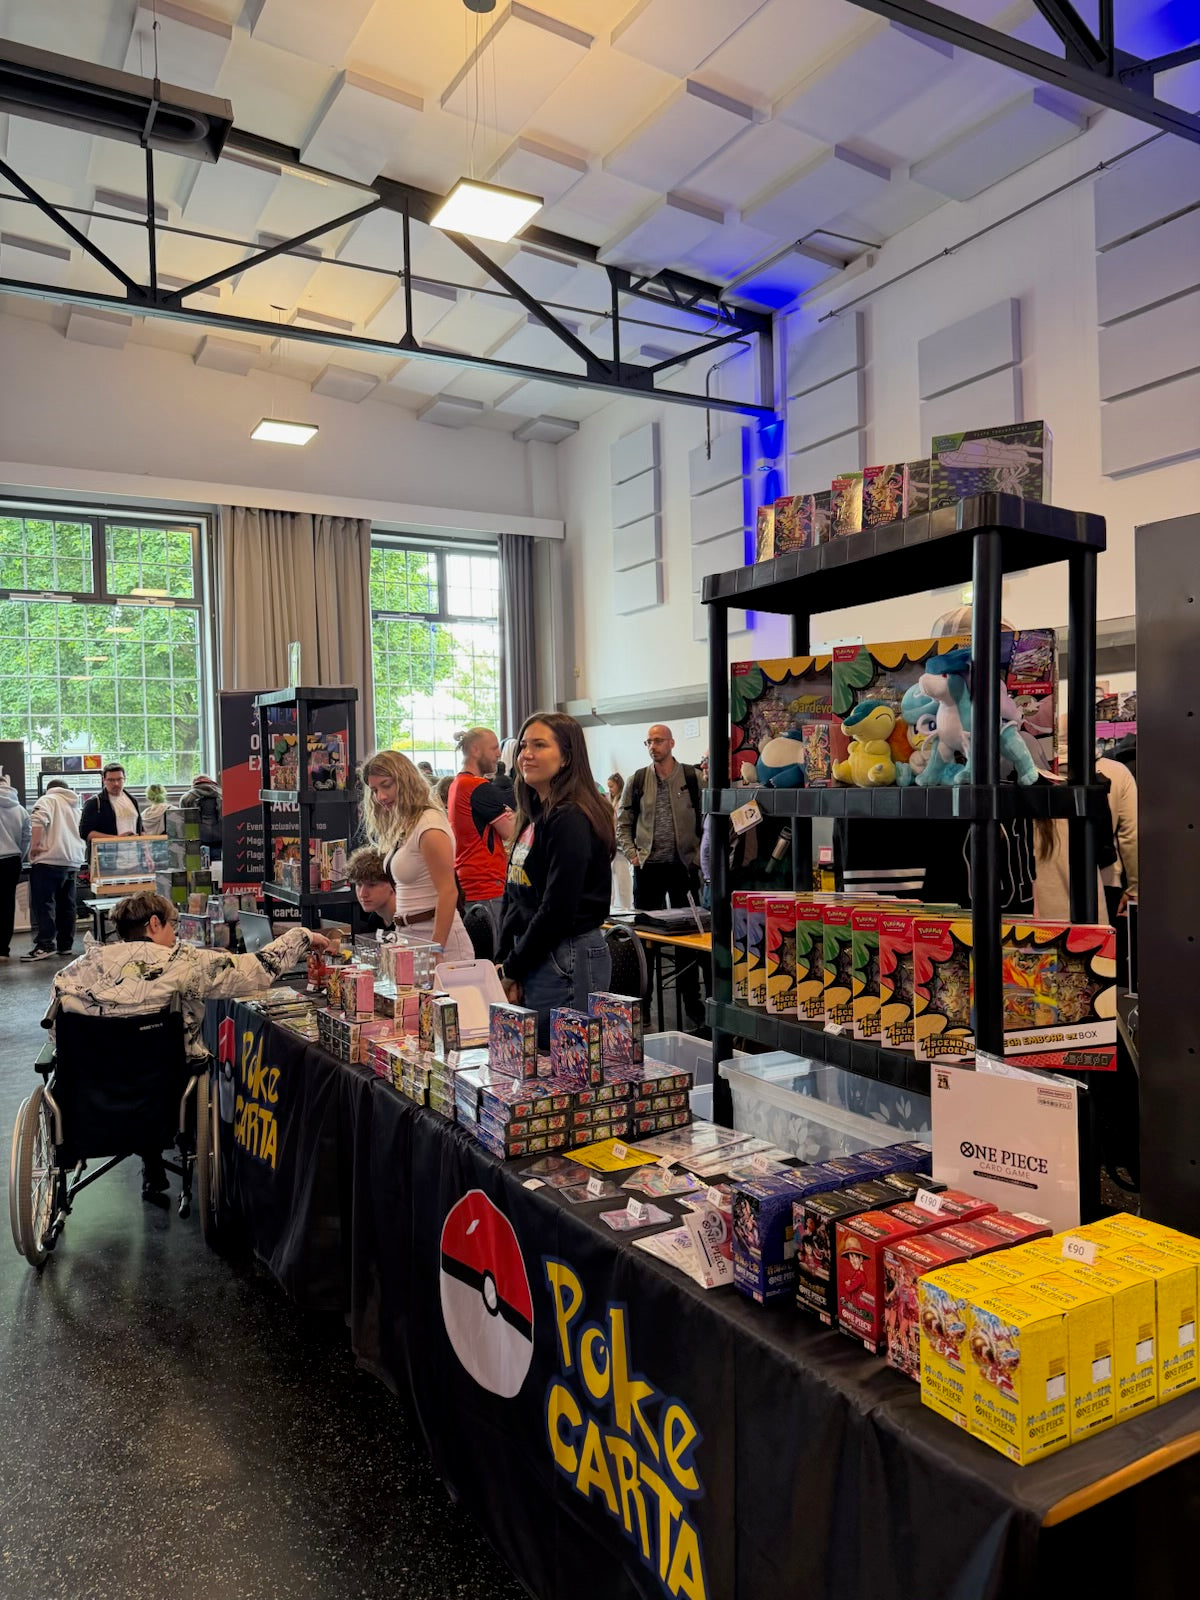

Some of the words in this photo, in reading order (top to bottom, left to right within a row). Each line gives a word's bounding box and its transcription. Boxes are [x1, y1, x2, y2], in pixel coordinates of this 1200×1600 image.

[1078, 1030, 1097, 1040] BOX
[921, 1038, 975, 1051] ASCENDED
[926, 1045, 966, 1058] HEROES
[234, 1095, 278, 1169] CARTA
[960, 1141, 997, 1163] ONE
[1001, 1150, 1048, 1174] PIECE
[979, 1162, 1002, 1173] CARD
[1006, 1168, 1031, 1179] GAME
[920, 1195, 937, 1208] €190
[702, 1220, 717, 1244] ONE
[711, 1245, 727, 1275] PIECE
[1067, 1242, 1085, 1256] €90
[545, 1260, 701, 1491] Poke
[547, 1383, 708, 1600] CARTA
